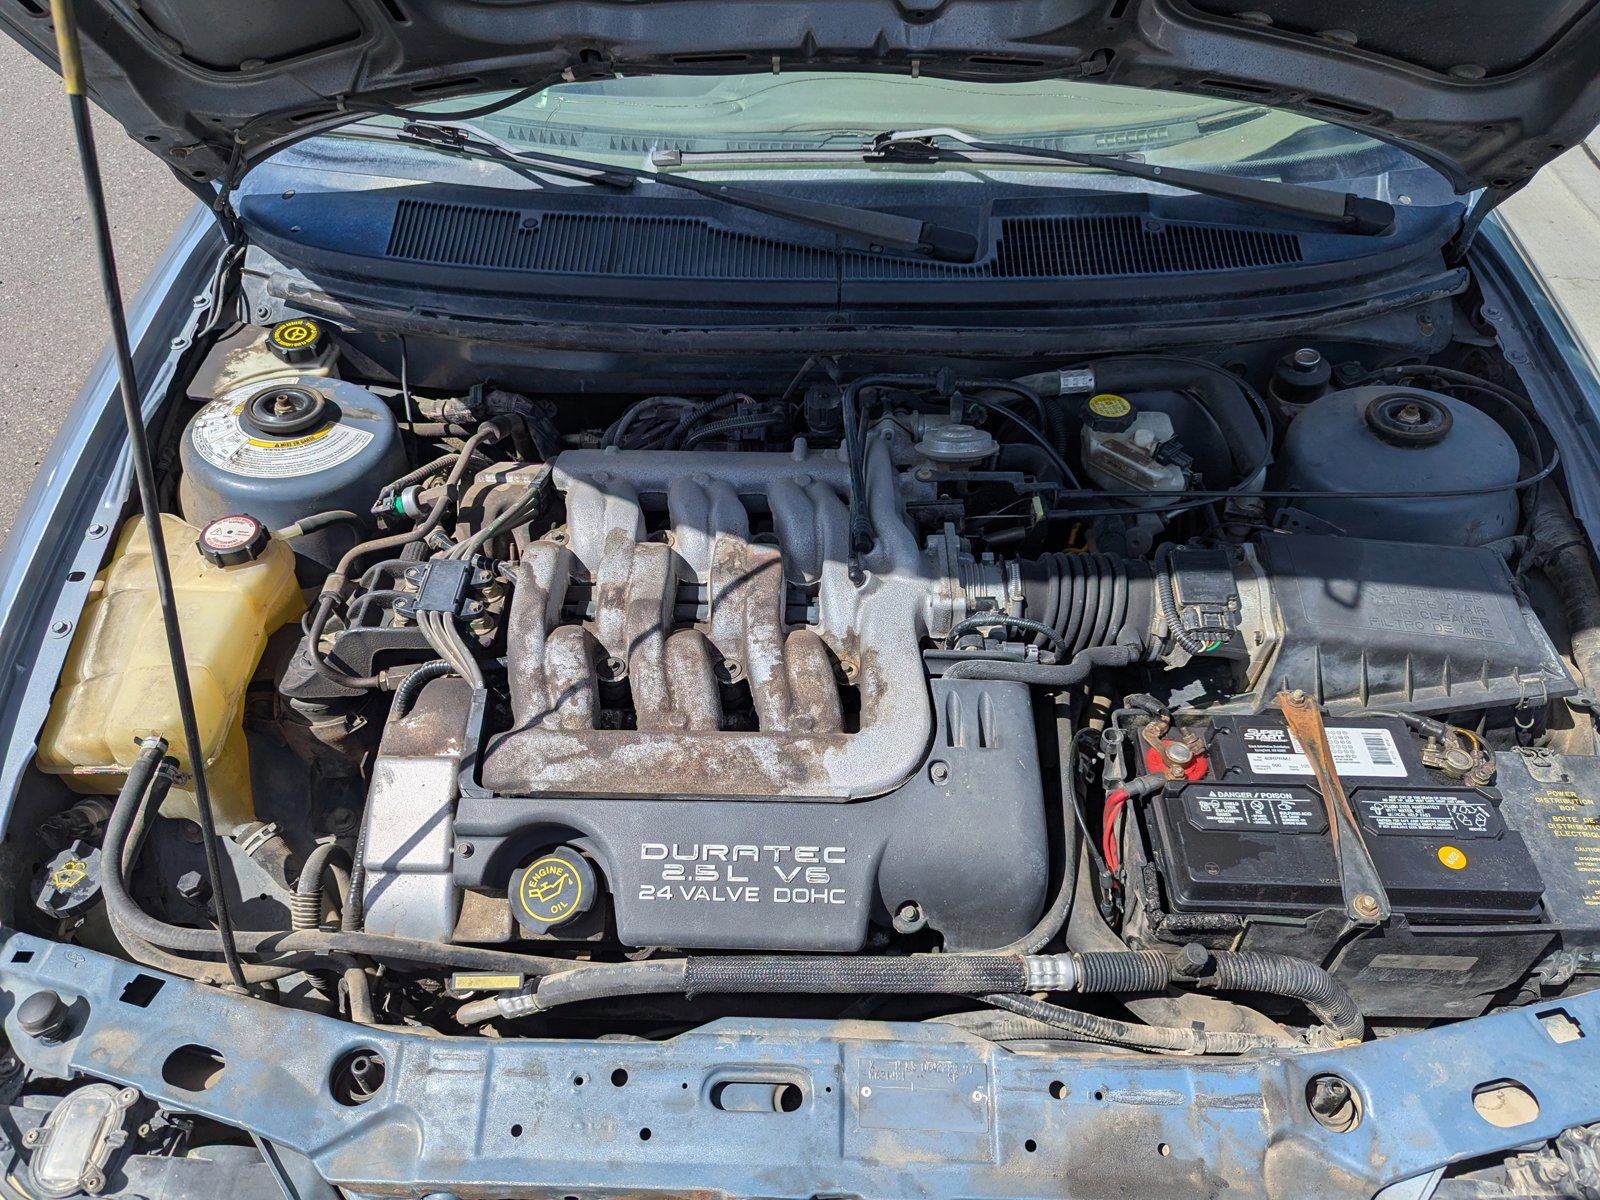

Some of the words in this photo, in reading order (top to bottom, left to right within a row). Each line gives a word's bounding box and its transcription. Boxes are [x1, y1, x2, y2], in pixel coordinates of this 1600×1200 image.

[1387, 584, 1482, 602] LUFTFILTER
[1420, 611, 1490, 626] CLEANER
[1464, 606, 1487, 615] AIR
[1369, 616, 1424, 630] FILTRO
[1433, 624, 1453, 633] DE
[1463, 628, 1495, 638] AIRE
[1535, 797, 1594, 805] DISTRIBUTION
[640, 843, 846, 864] DURATEC
[528, 866, 564, 888] ENGINE
[773, 866, 830, 884] V6
[638, 885, 673, 900] 24
[680, 886, 760, 902] VALVE
[773, 888, 846, 904] DOHC
[550, 902, 568, 914] OIL
